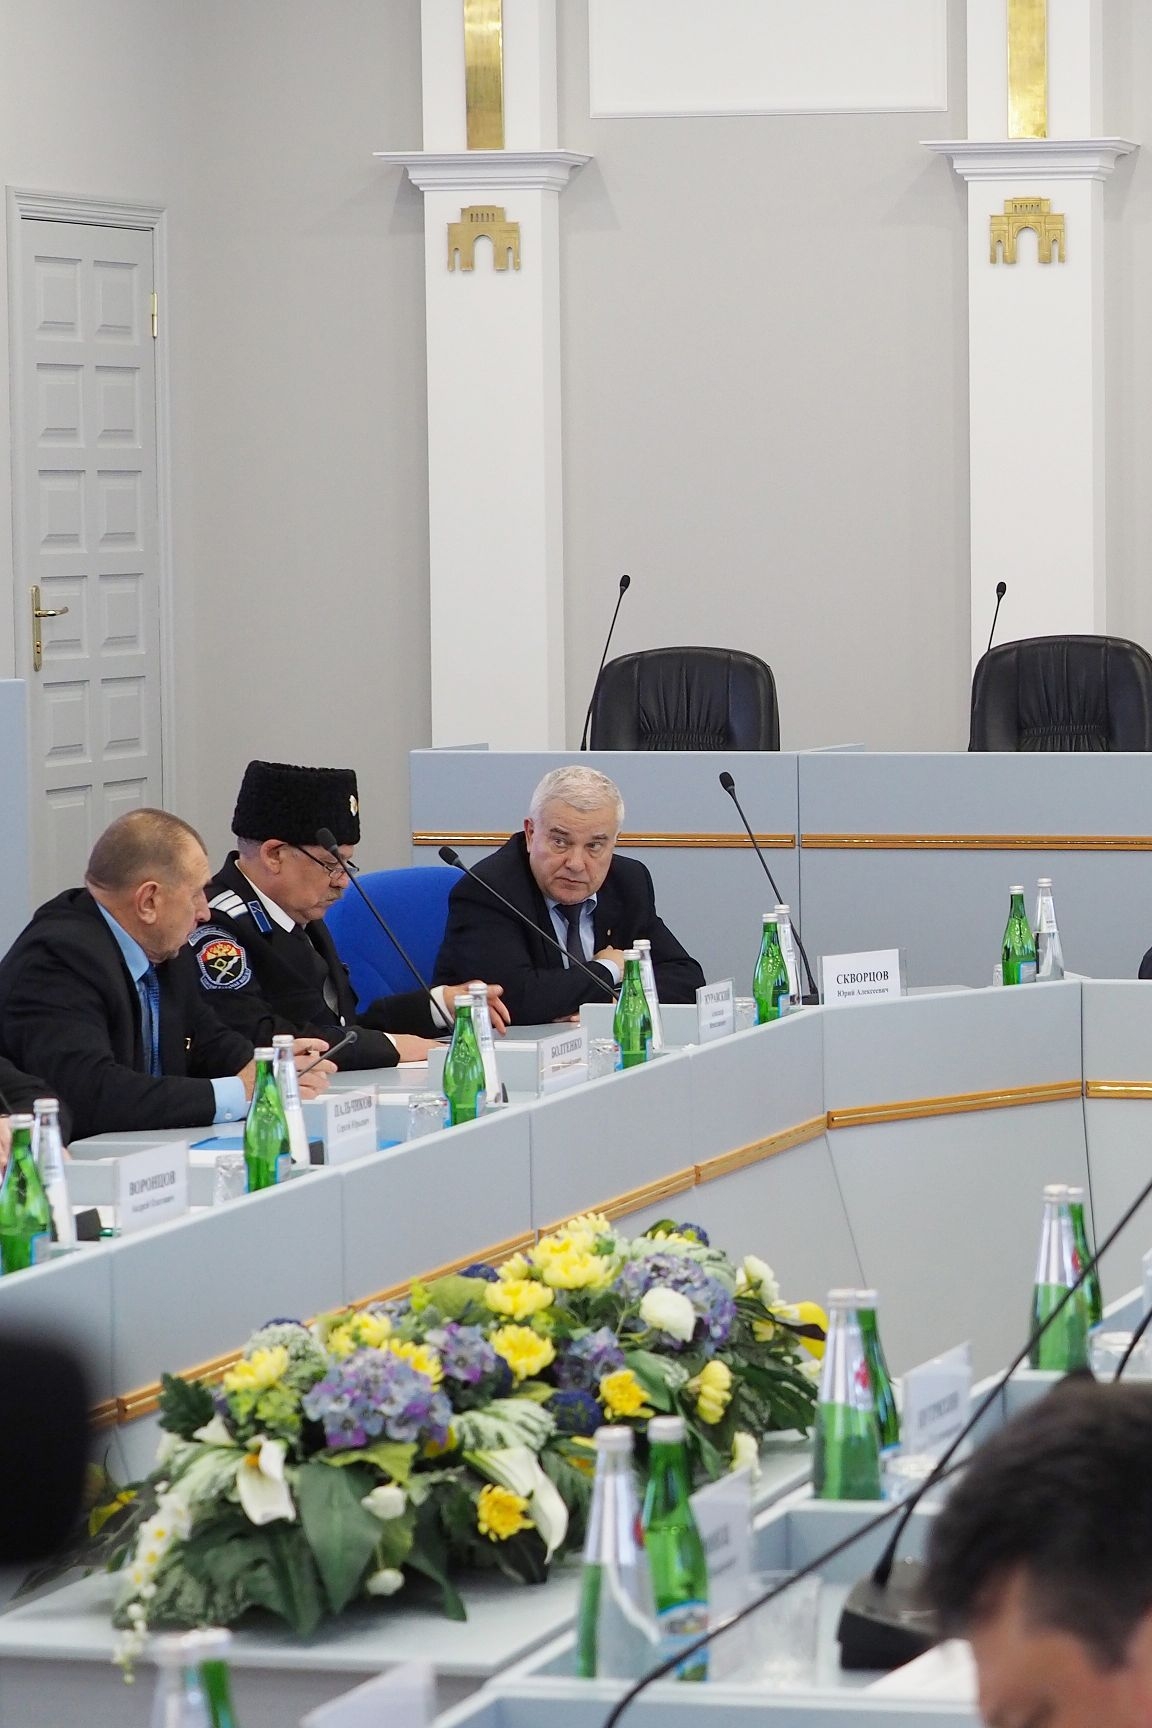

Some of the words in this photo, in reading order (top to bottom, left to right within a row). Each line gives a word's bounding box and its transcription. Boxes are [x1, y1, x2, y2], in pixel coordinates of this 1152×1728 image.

[836, 970, 889, 985] СКВОРЦОВ
[837, 989, 855, 999] Юрий
[856, 987, 889, 996] Алексеевич
[129, 1170, 176, 1196] ВОРОНЦОВ
